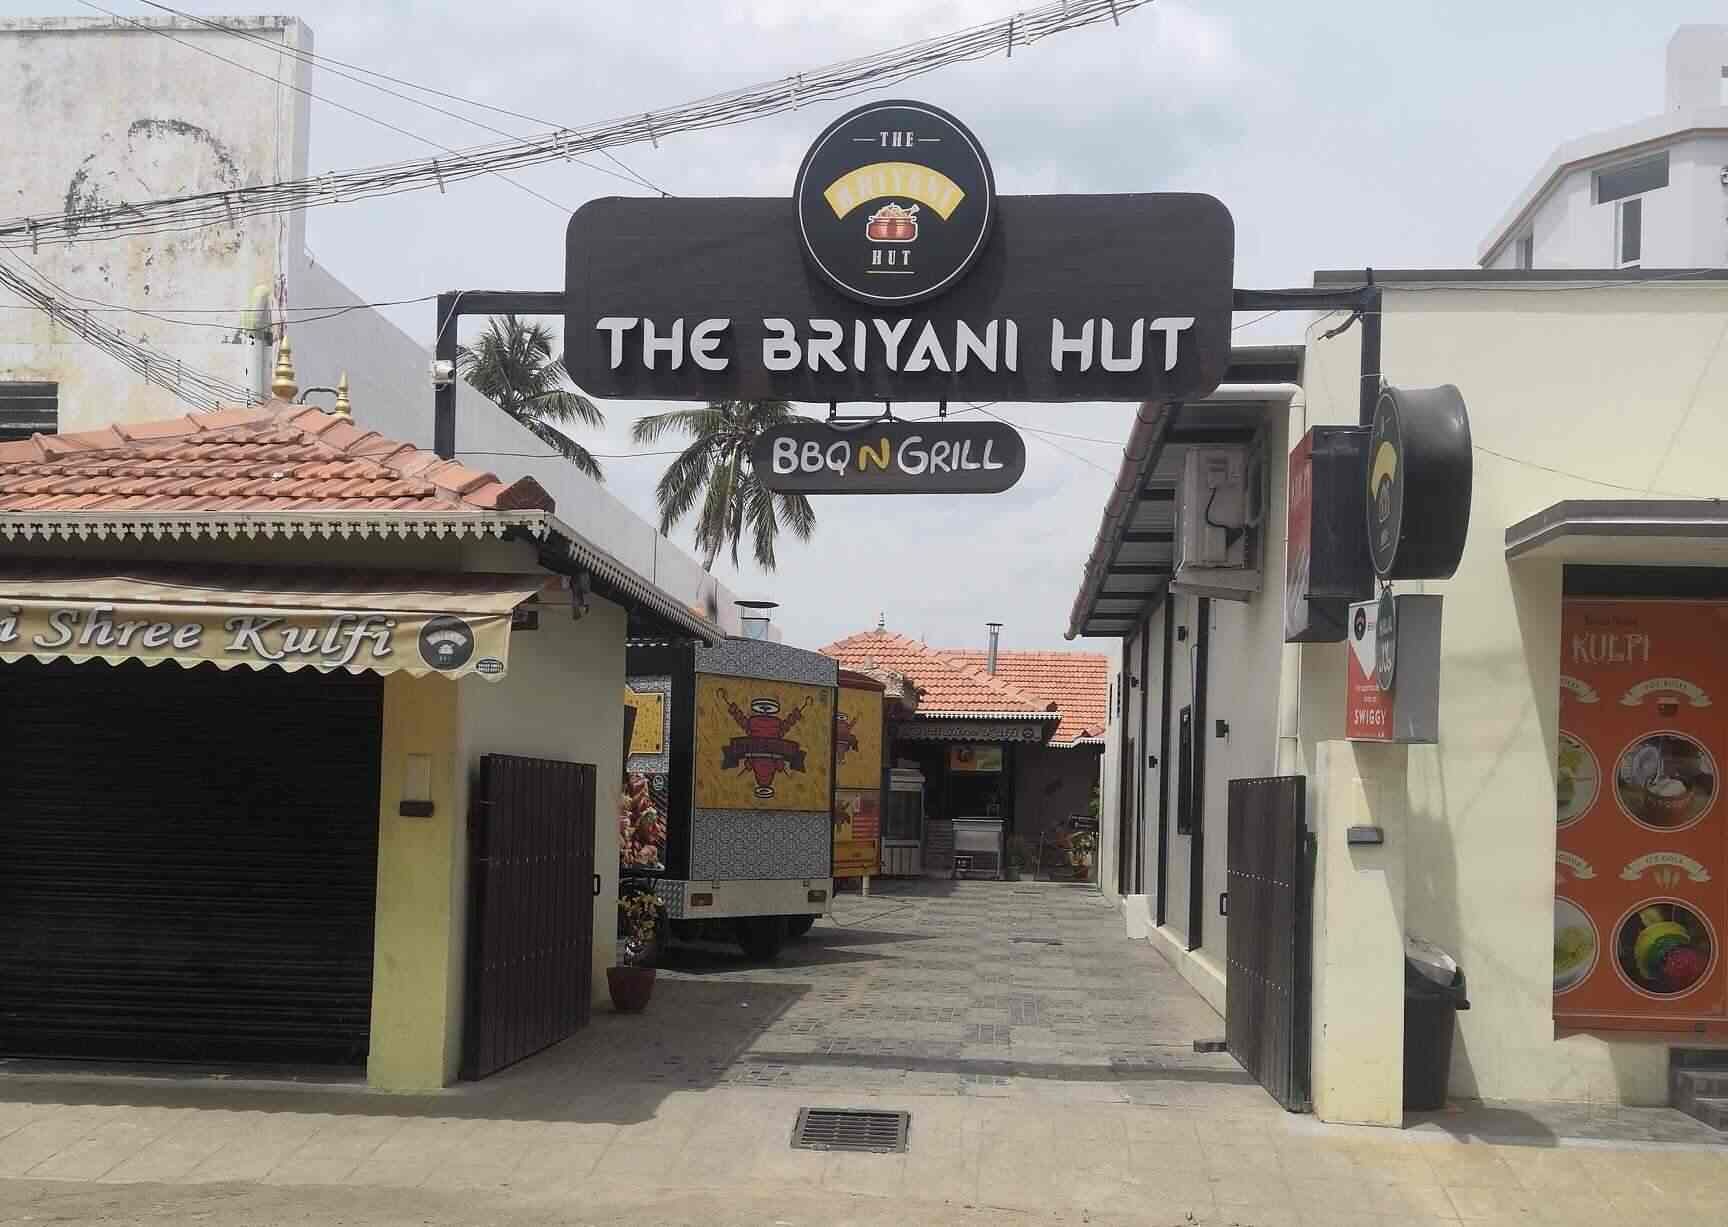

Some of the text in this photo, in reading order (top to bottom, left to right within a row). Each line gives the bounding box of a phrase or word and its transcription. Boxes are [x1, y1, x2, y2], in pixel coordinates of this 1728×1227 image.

[879, 131, 914, 147] THE
[872, 249, 911, 265] HUT
[596, 316, 1197, 373] THE BRIYANI HUT
[772, 435, 1004, 477] BBQ N GRILL
[32, 602, 204, 649] Shree
[224, 614, 397, 667] Kulfi
[1353, 708, 1387, 726] SWIGGY
